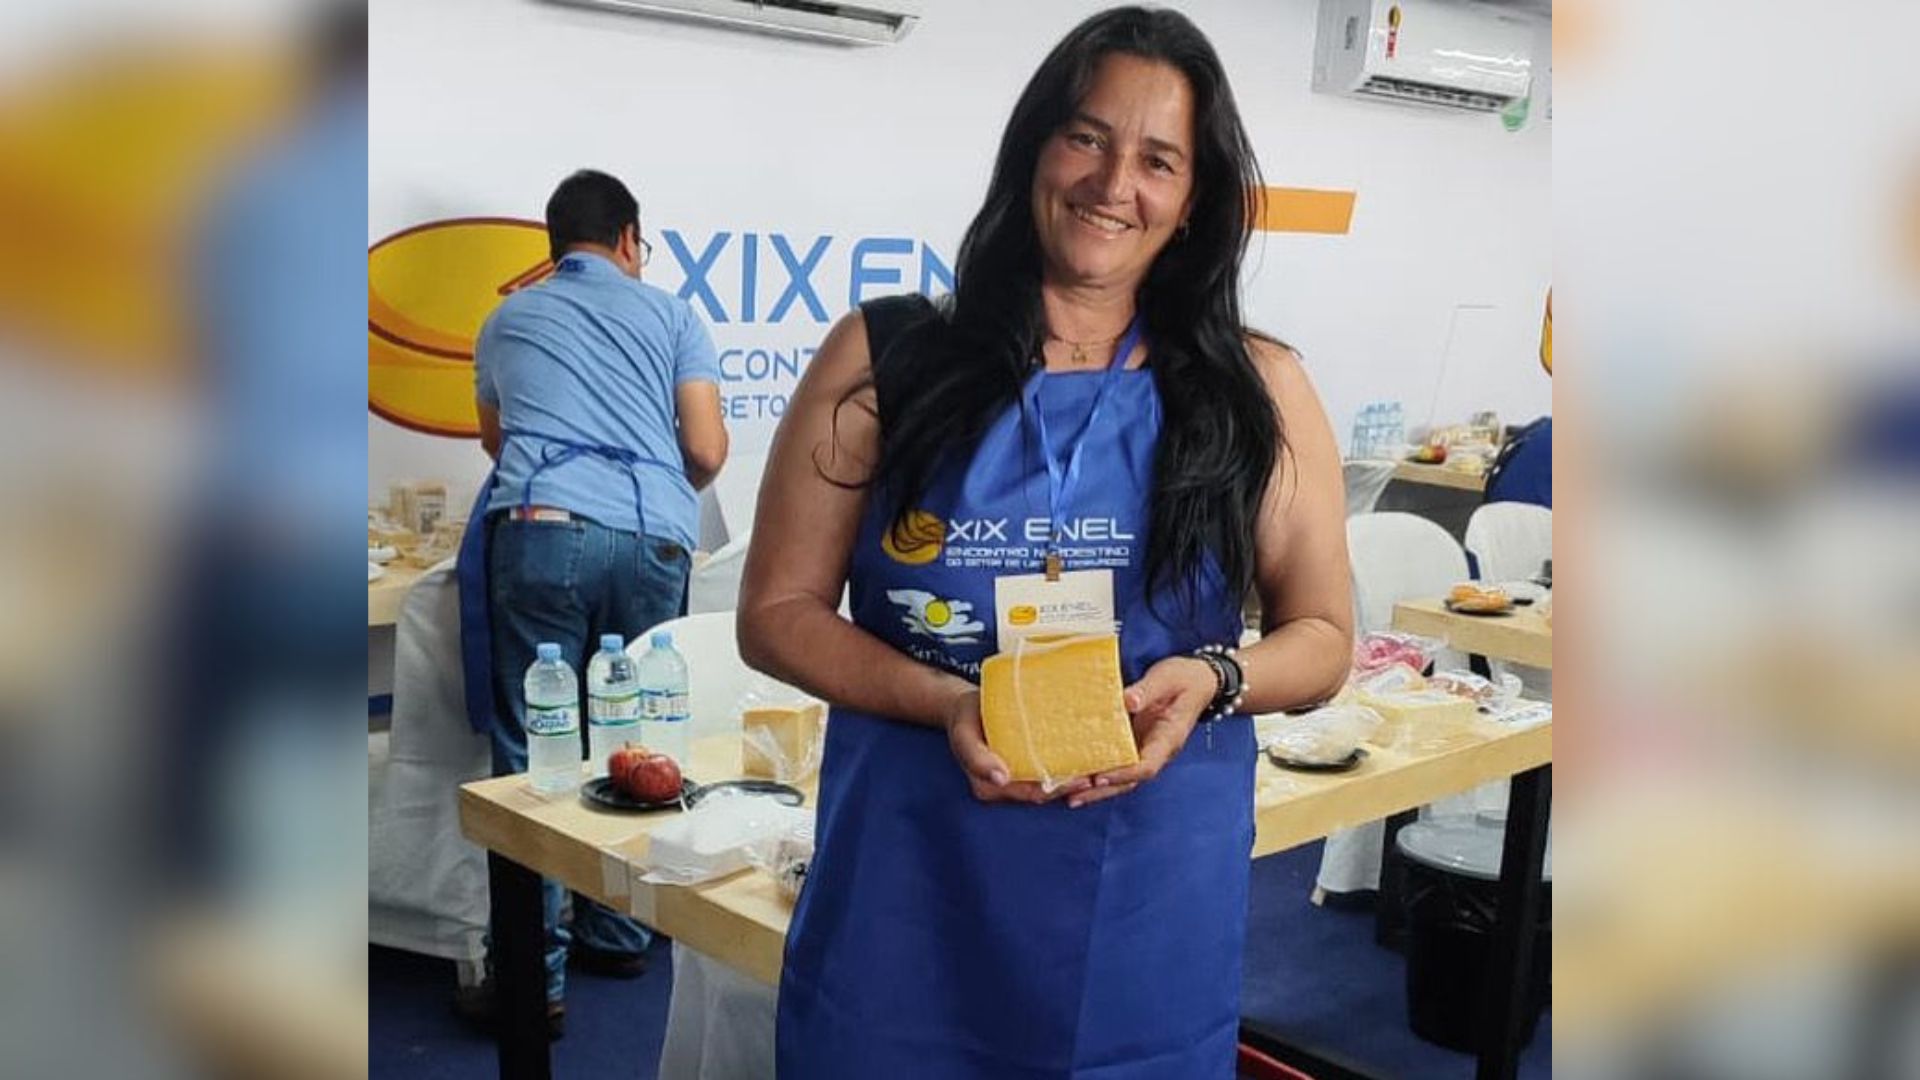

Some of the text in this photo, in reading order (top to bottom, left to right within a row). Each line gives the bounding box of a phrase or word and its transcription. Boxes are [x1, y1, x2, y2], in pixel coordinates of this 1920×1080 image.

[661, 229, 833, 323] XIX
[719, 347, 818, 382] CON
[946, 517, 1135, 543] XIX ENEL
